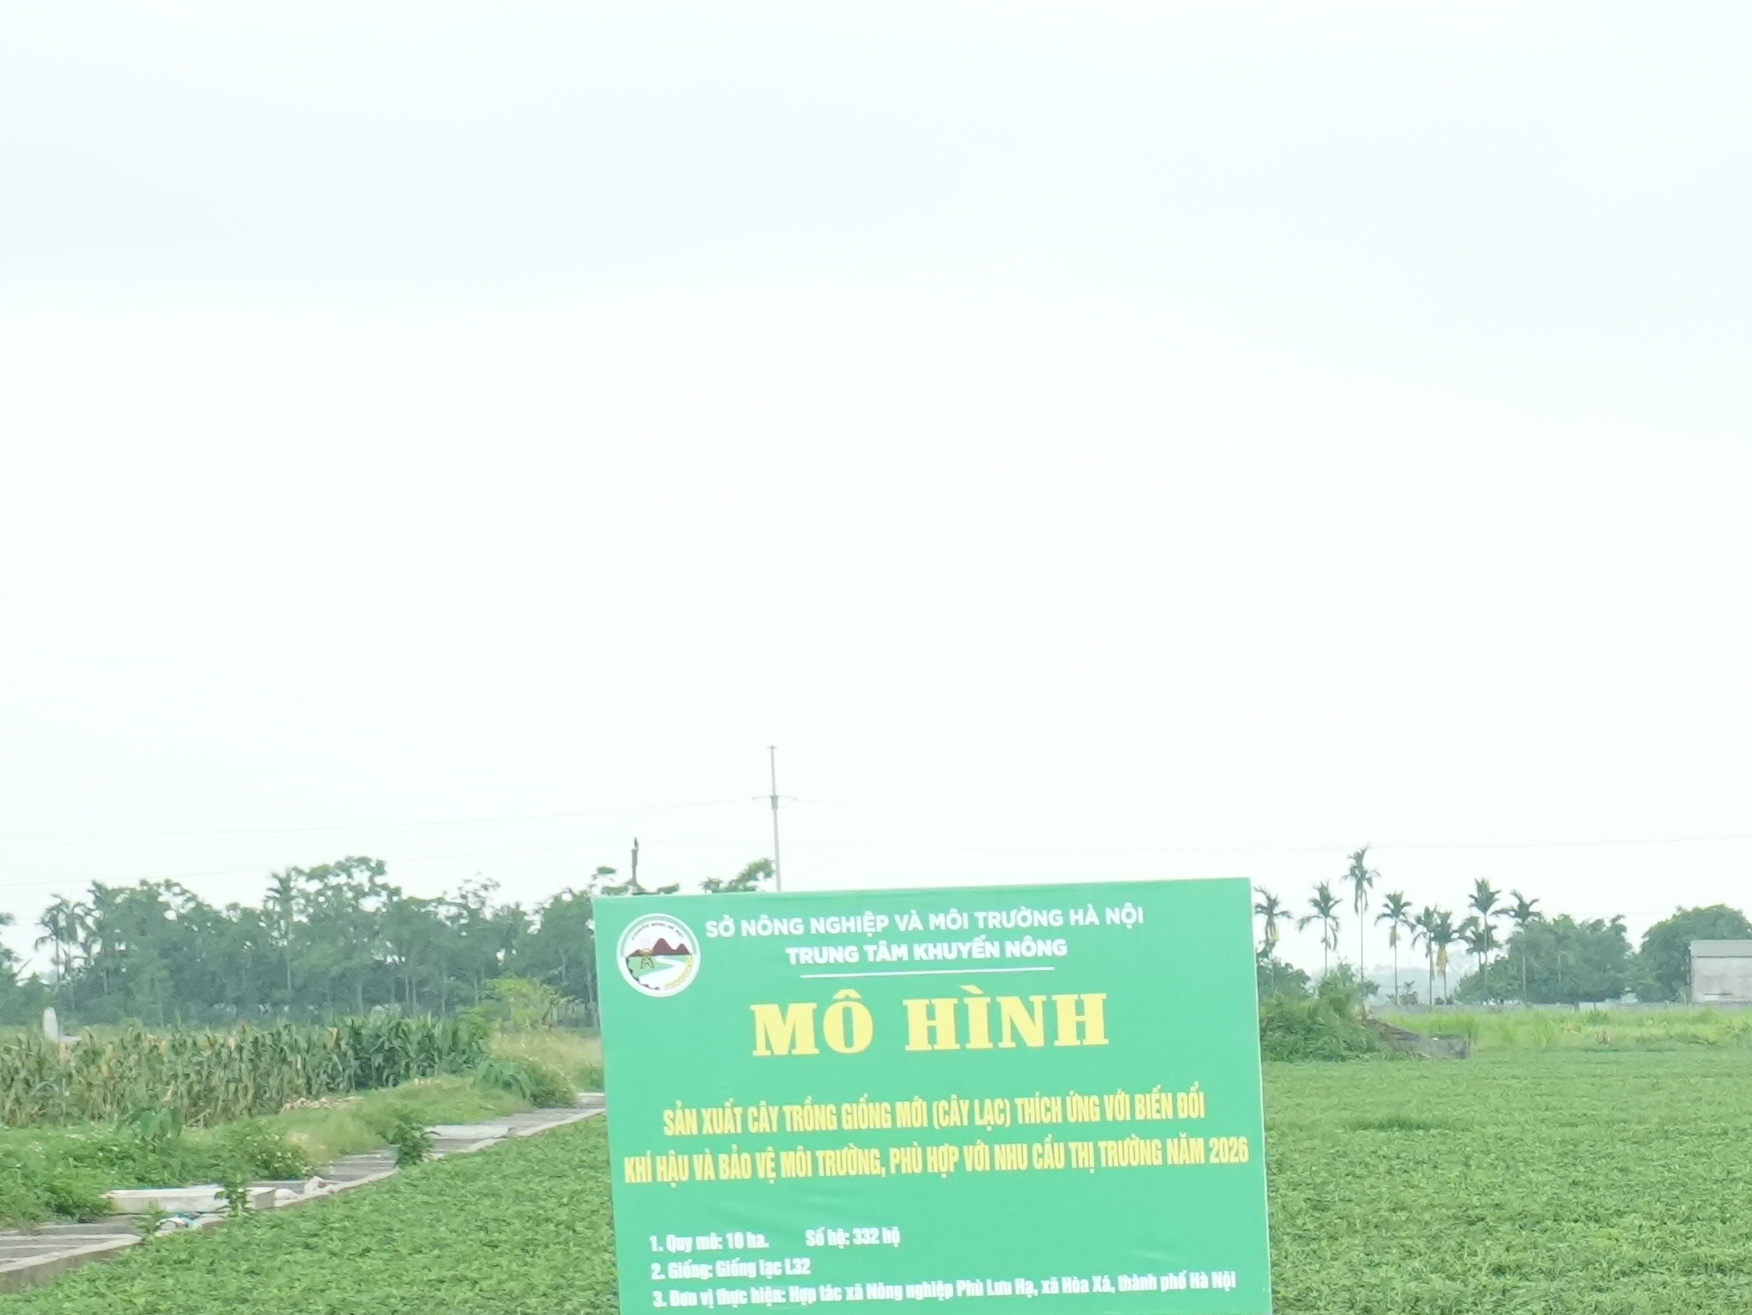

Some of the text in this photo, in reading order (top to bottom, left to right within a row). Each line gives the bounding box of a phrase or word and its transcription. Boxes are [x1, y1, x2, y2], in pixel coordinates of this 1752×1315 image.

[706, 915, 735, 938] SỞ
[741, 915, 804, 936] NÔNG
[810, 911, 889, 937] NGHIỆP
[895, 910, 924, 931] VÀ
[929, 908, 968, 930] MÔI
[974, 906, 1063, 928] TRƯỜNG
[1070, 904, 1100, 925] HÀ
[1105, 902, 1143, 928] NỘI
[786, 934, 1067, 964] TRUNG TÂM KHUYẾN NÔNG
[750, 985, 1109, 1057] MÔ HÌNH
[663, 1082, 1205, 1136] SẢN XUẤT CÂY TRỒNG GIỐNG MỚI (CÂY LẠC) THÍCH ỨNG VỚI BIẾN ĐỔI
[624, 1133, 1249, 1187] KHÍ HẬU VÀ BẢO VỆ MÔI TRƯỜNG, PHÙ HỢP VỚI NHU CẦU THỊ TRƯỜNG NĂM 2026
[650, 1226, 900, 1253] 1. Quy mô: 10 ha. Số hộ: 332 hộ
[651, 1258, 811, 1280] 2. Giống: Giống lạc L32
[653, 1270, 1236, 1308] 3. Đơn vị thực hiện: Hợp tác xã Nông nghiệp Phù Lưu Hạ, xã Hòa Xá, thành phố Hà Nội
